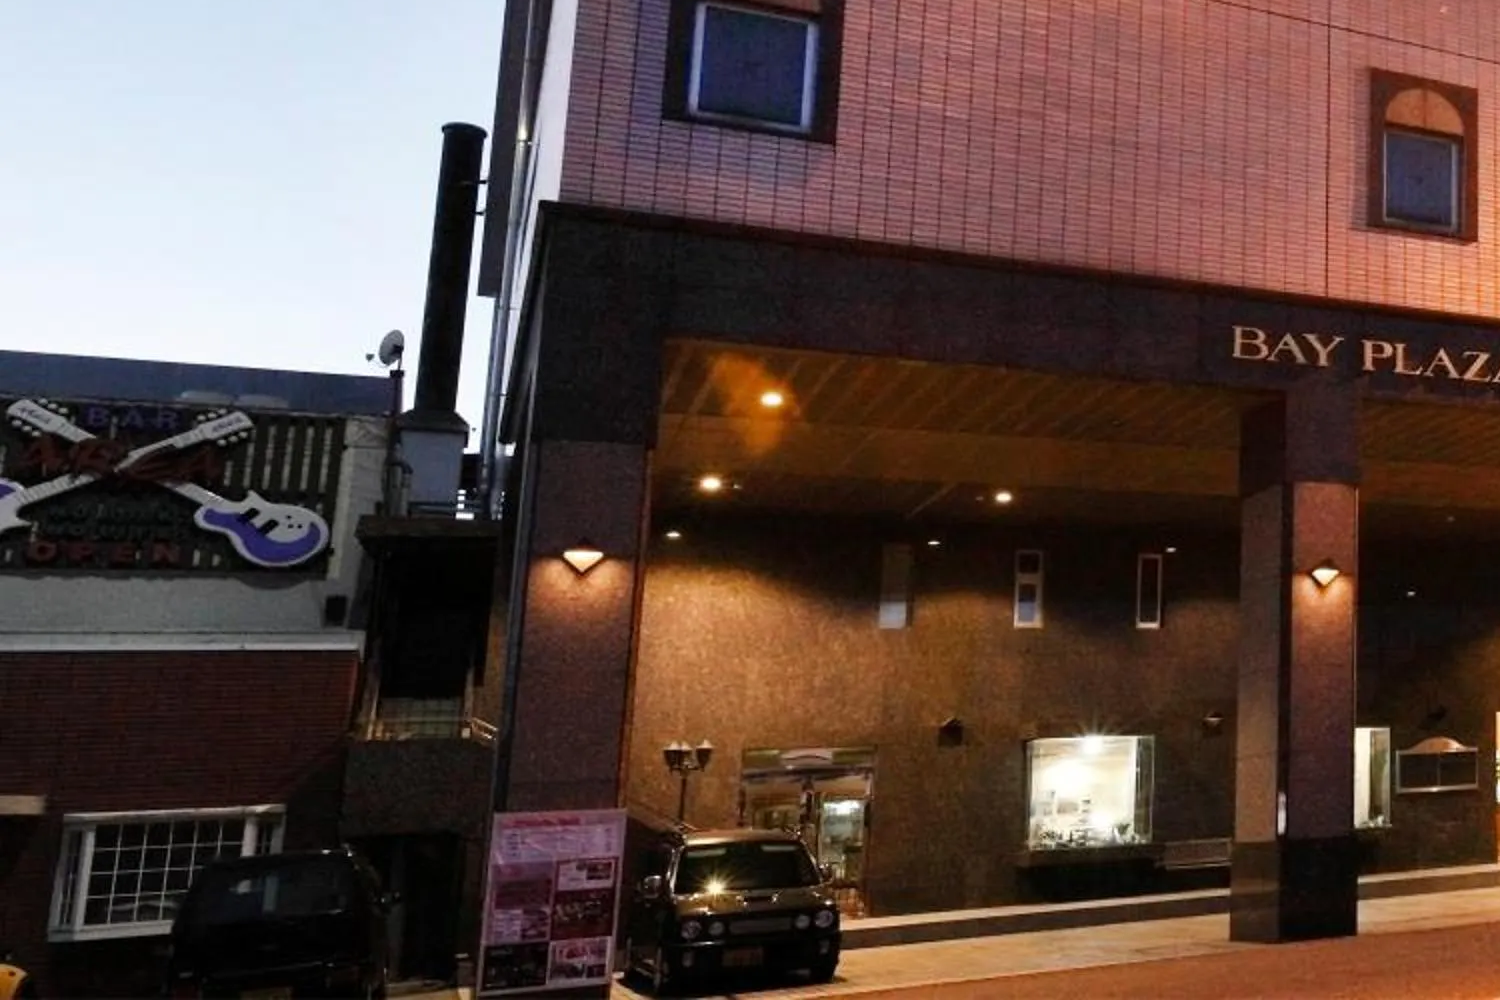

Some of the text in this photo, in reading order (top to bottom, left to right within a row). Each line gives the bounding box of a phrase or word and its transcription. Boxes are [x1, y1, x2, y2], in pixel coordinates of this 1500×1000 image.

[1231, 325, 1343, 367] BAY
[88, 405, 181, 429] BAR
[27, 540, 180, 564] OPEN
